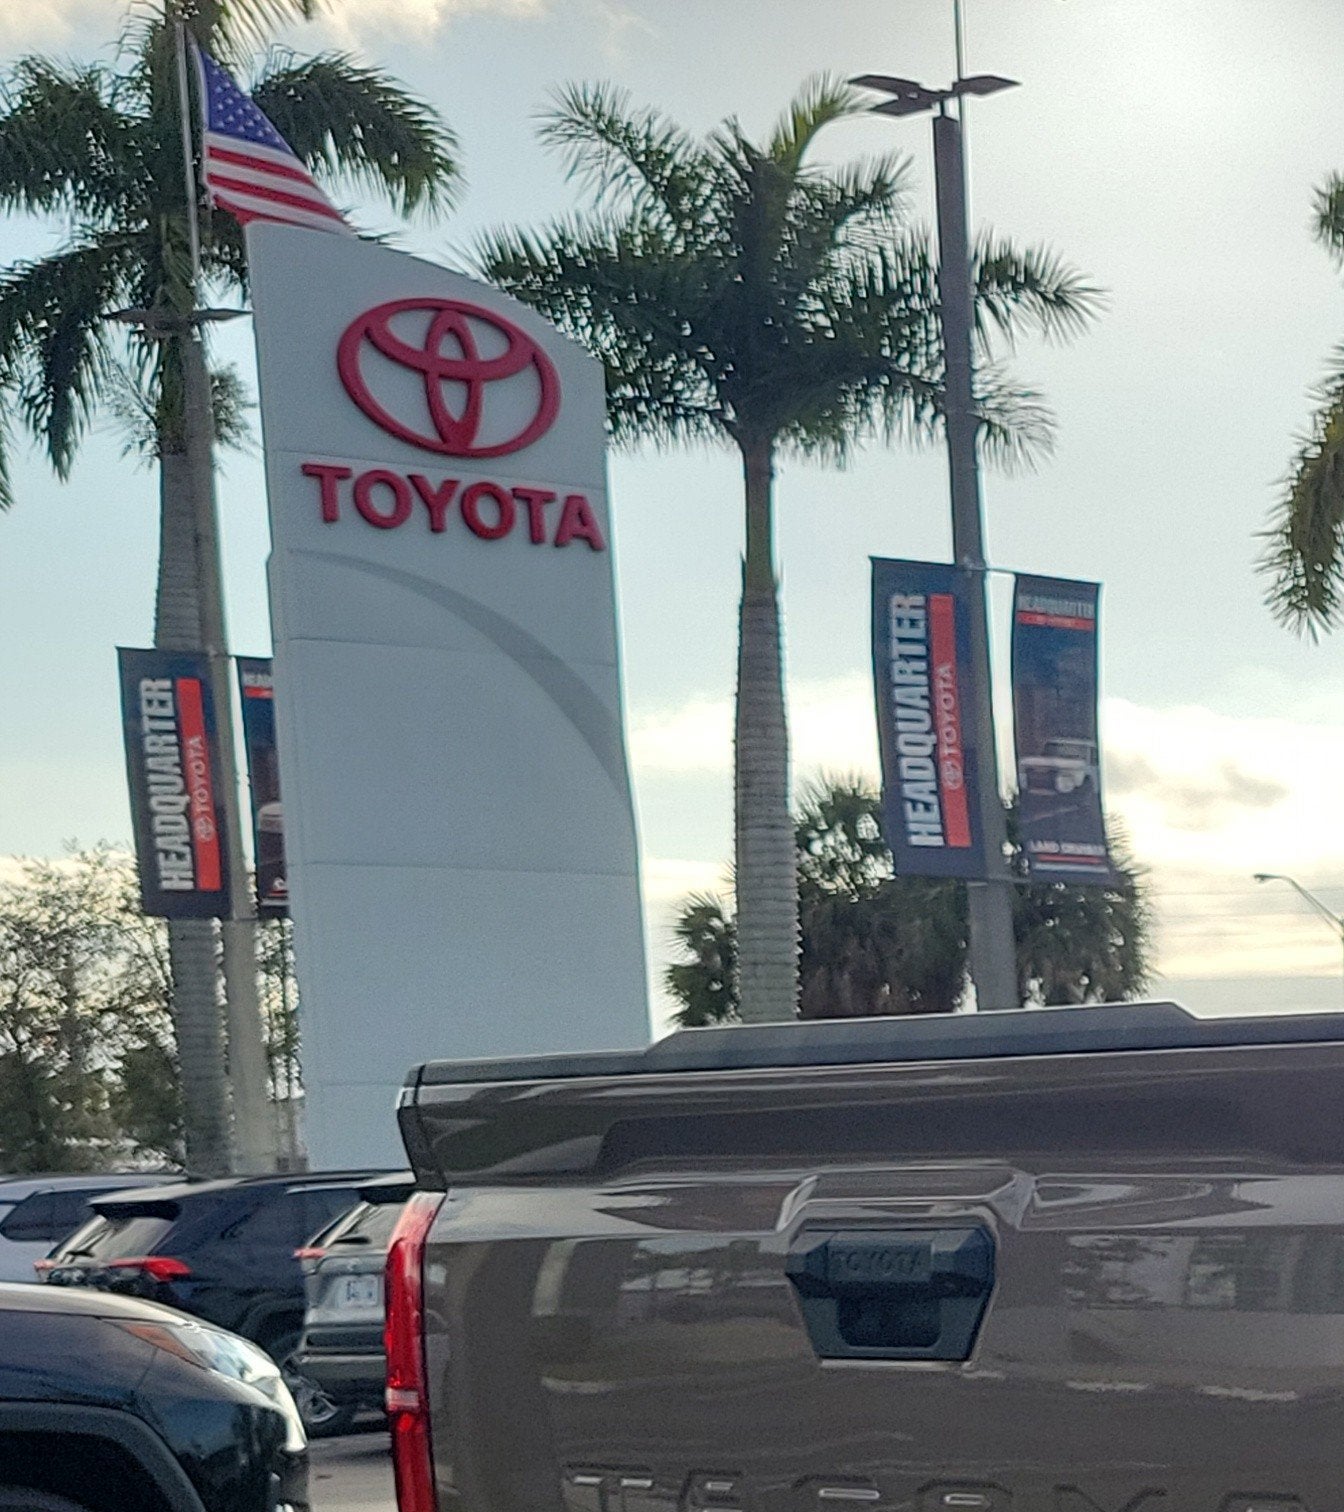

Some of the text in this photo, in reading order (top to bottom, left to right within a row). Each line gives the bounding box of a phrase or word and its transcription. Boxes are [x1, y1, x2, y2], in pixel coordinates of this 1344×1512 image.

[301, 463, 605, 551] TOYOTA
[890, 594, 946, 847] HEADQUARTER
[935, 665, 962, 757] TOYOTA
[139, 678, 195, 891] HEADQUARTER
[187, 735, 213, 815] TOYOTA
